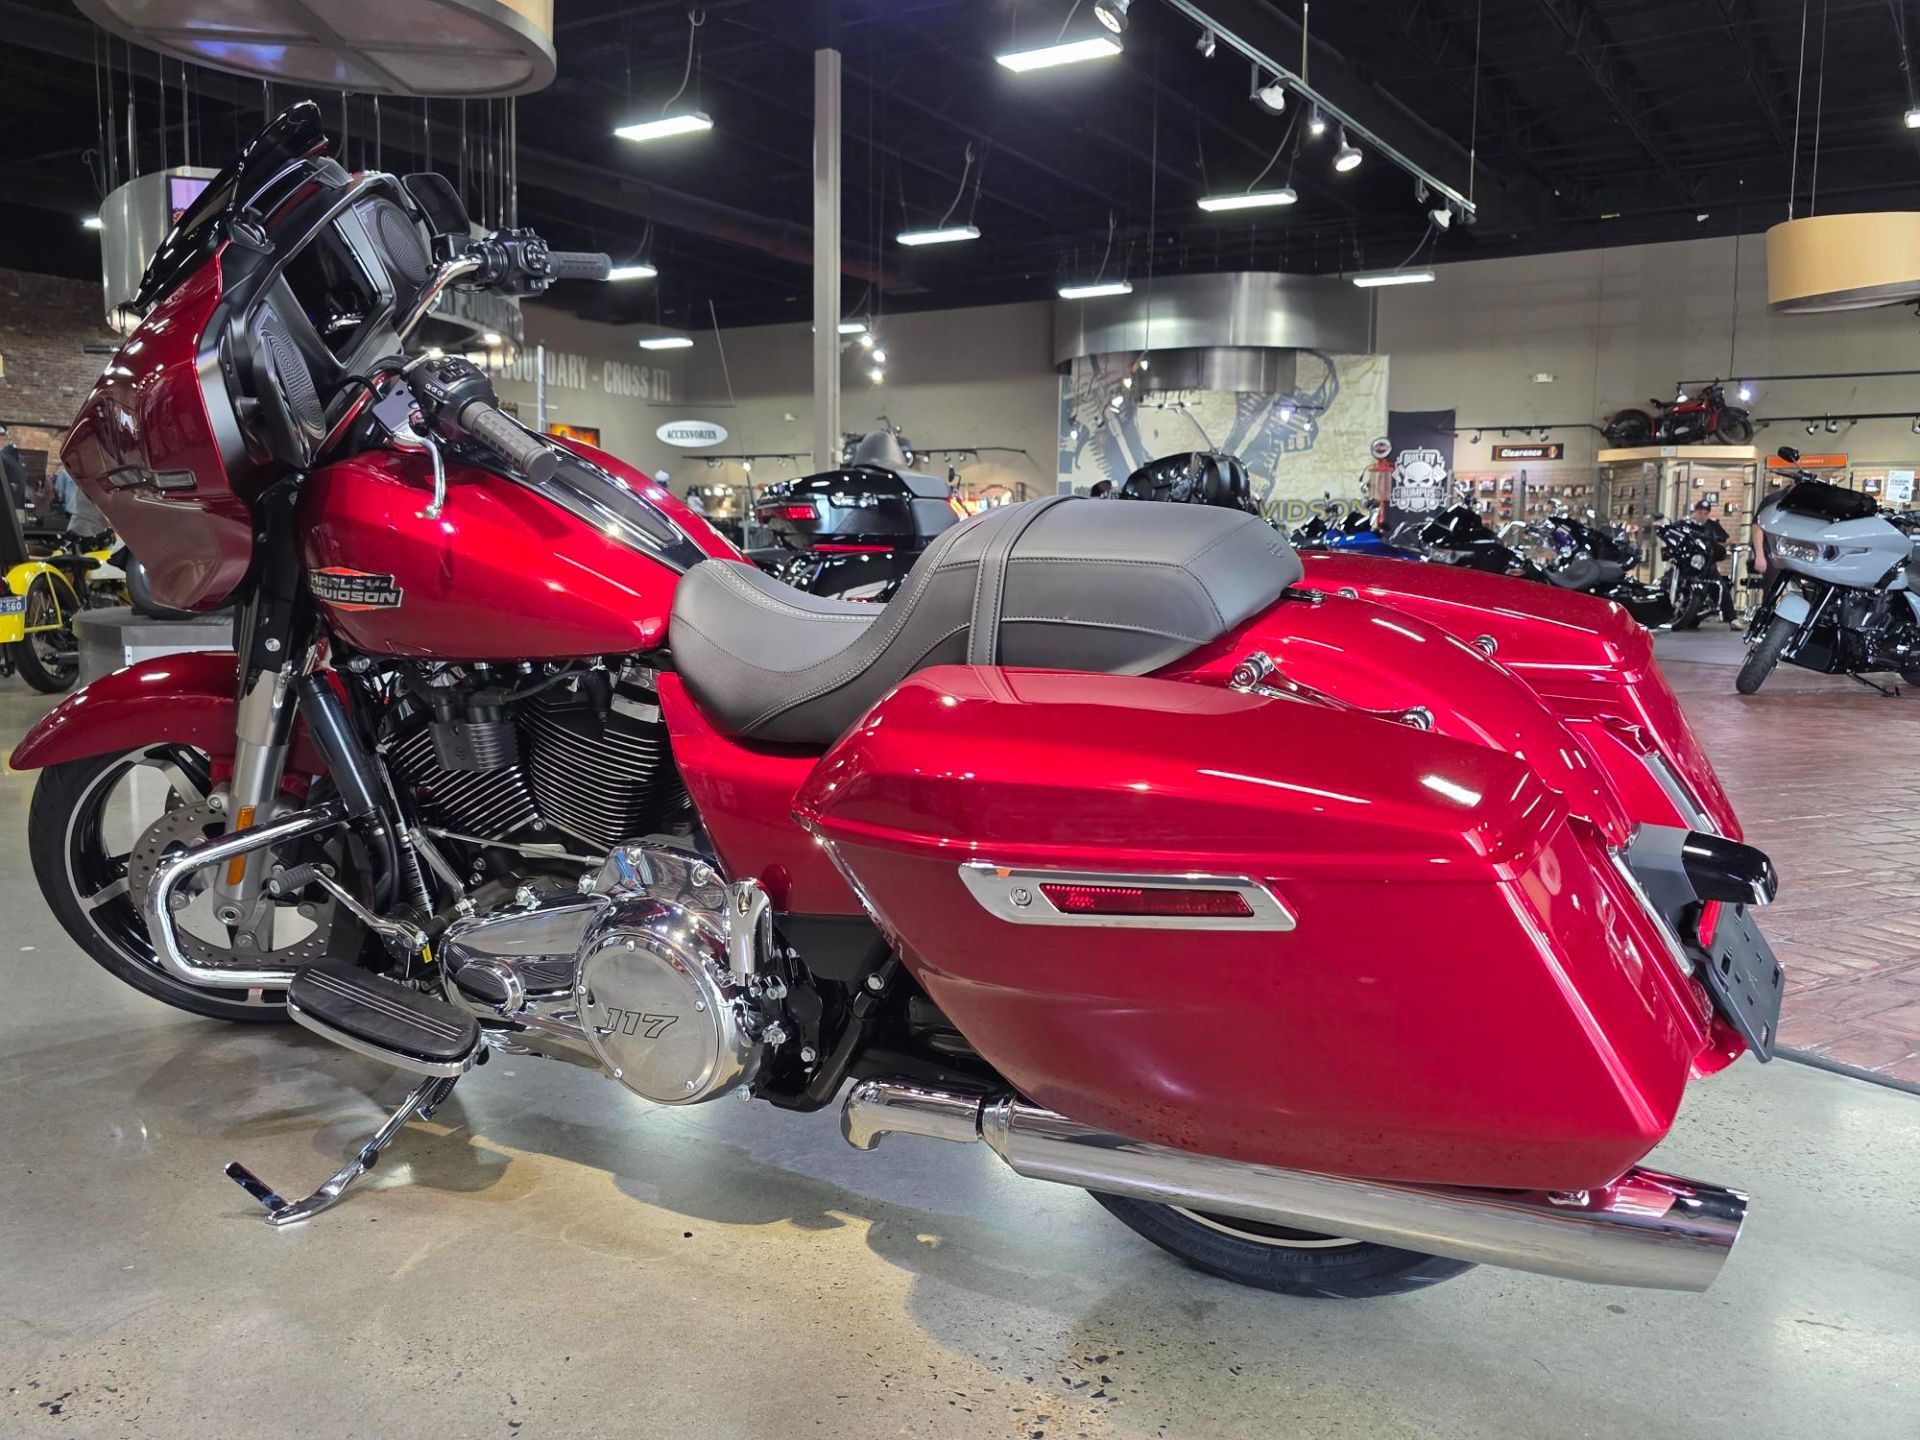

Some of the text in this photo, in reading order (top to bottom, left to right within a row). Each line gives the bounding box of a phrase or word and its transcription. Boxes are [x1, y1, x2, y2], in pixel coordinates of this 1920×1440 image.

[501, 346, 588, 391] OUDARY
[603, 360, 649, 398] CROSS
[653, 369, 671, 401] IT!
[667, 430, 717, 440] ACCESSORIES
[1501, 448, 1542, 457] Clearance
[310, 585, 396, 603] DAVIDSON
[606, 1007, 679, 1039] 117
